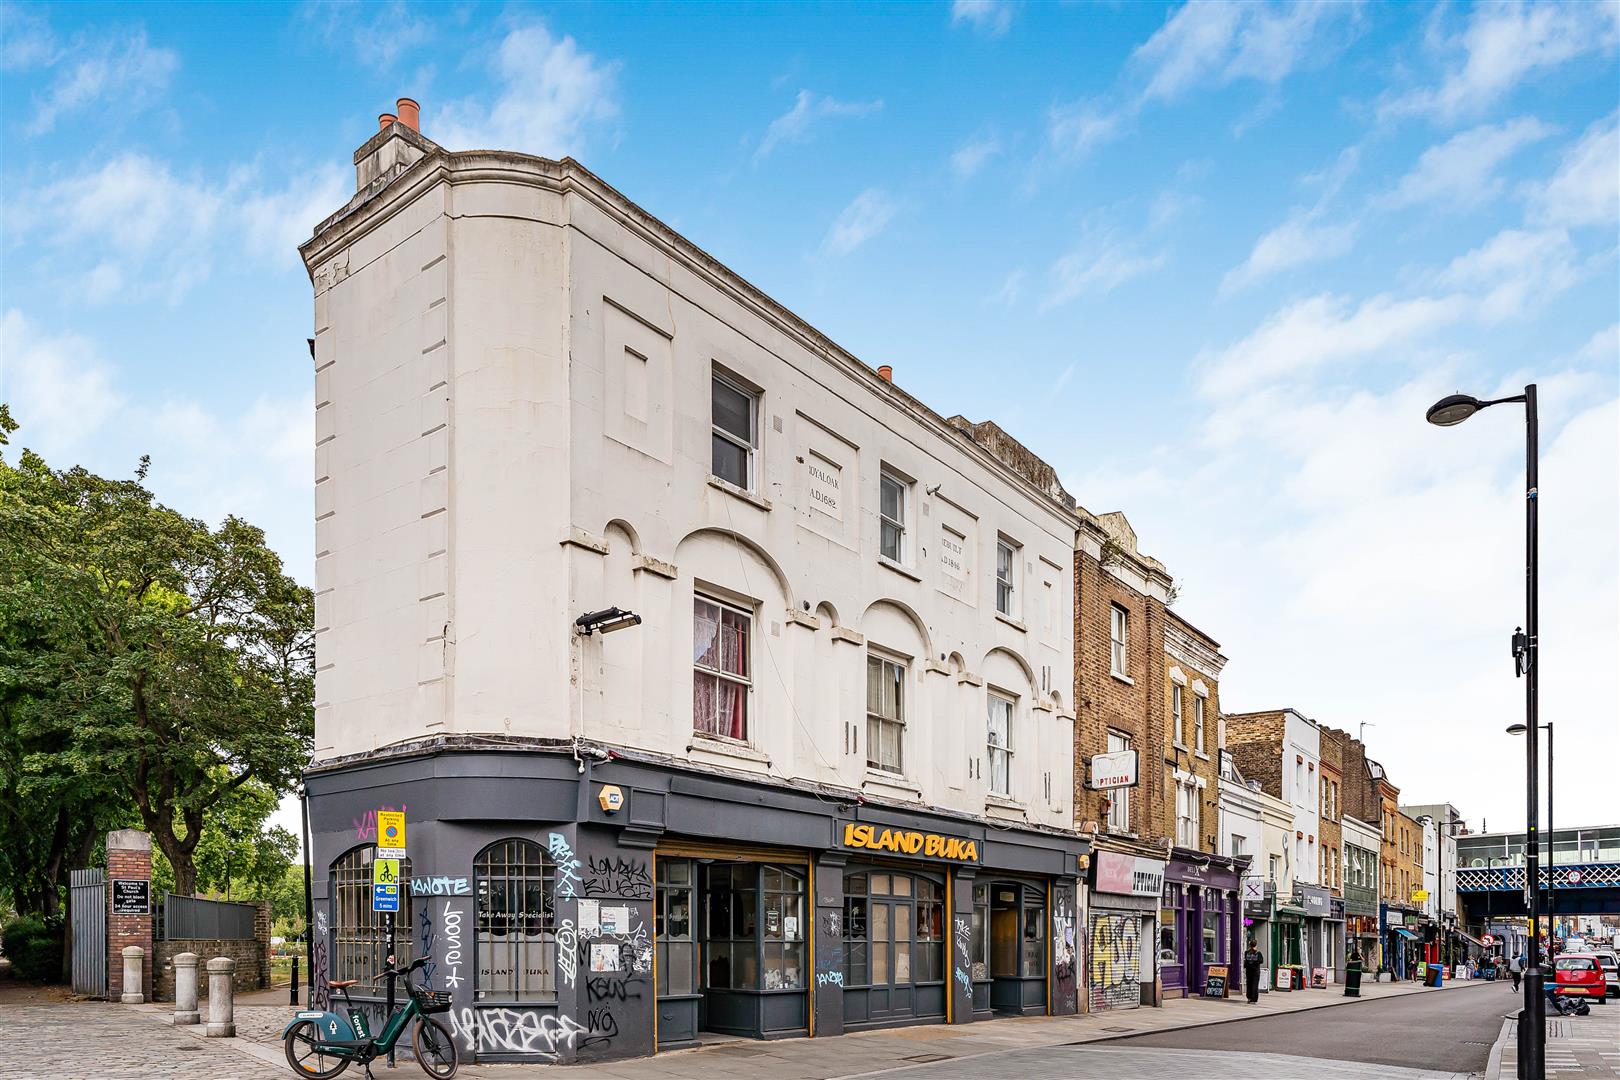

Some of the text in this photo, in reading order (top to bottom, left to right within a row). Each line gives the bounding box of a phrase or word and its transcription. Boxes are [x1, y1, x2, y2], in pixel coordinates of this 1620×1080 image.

[844, 823, 978, 861] ISLAND BUKA
[1246, 884, 1261, 896] X
[481, 968, 514, 976] ISLAND
[352, 1014, 366, 1039] forest
